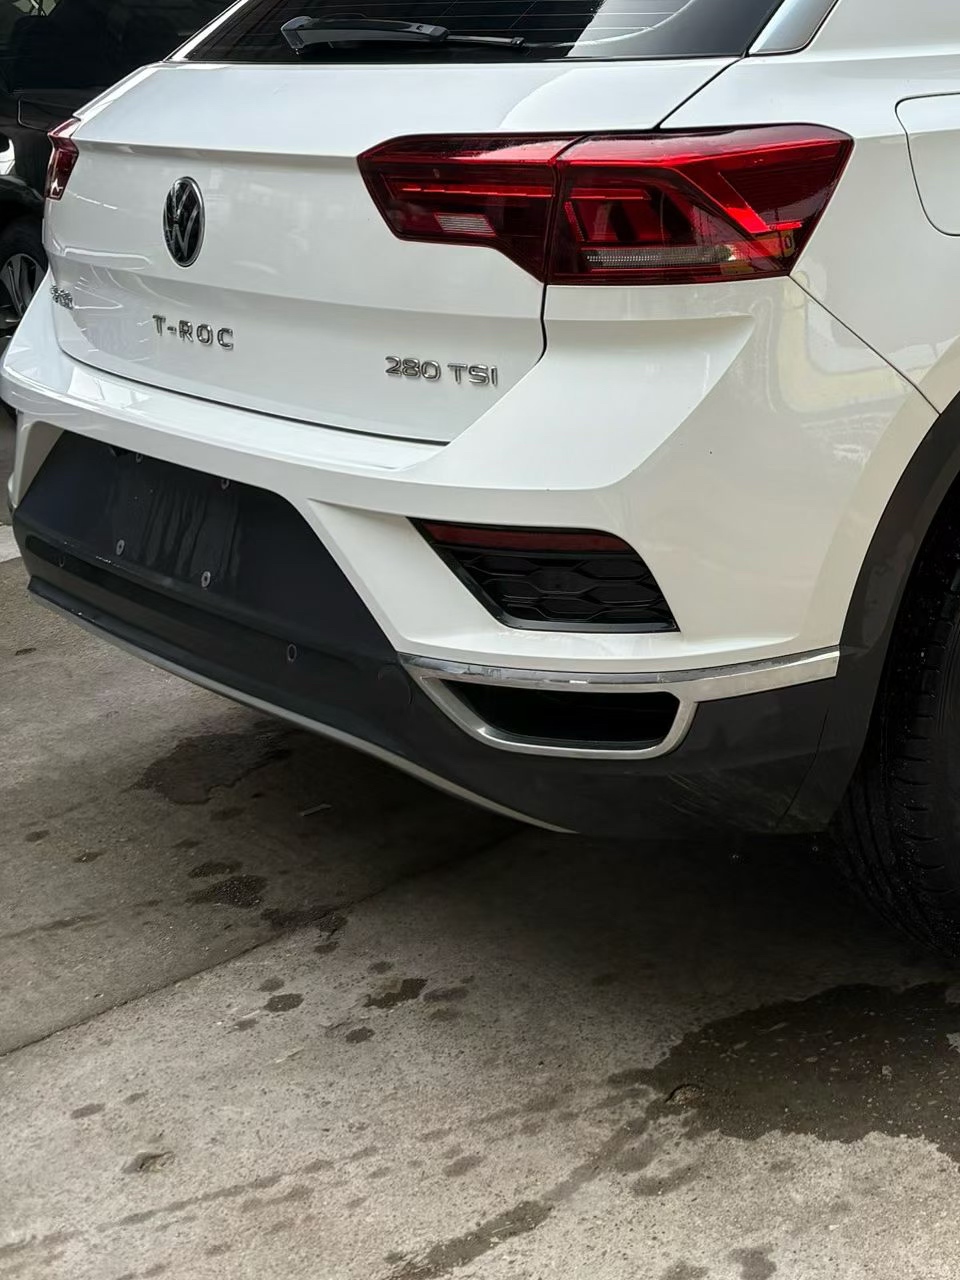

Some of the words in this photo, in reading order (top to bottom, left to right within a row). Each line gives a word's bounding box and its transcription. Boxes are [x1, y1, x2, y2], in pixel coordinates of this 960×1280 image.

[152, 314, 234, 350] T-ROC
[385, 356, 442, 381] 280
[447, 363, 498, 387] TSI
